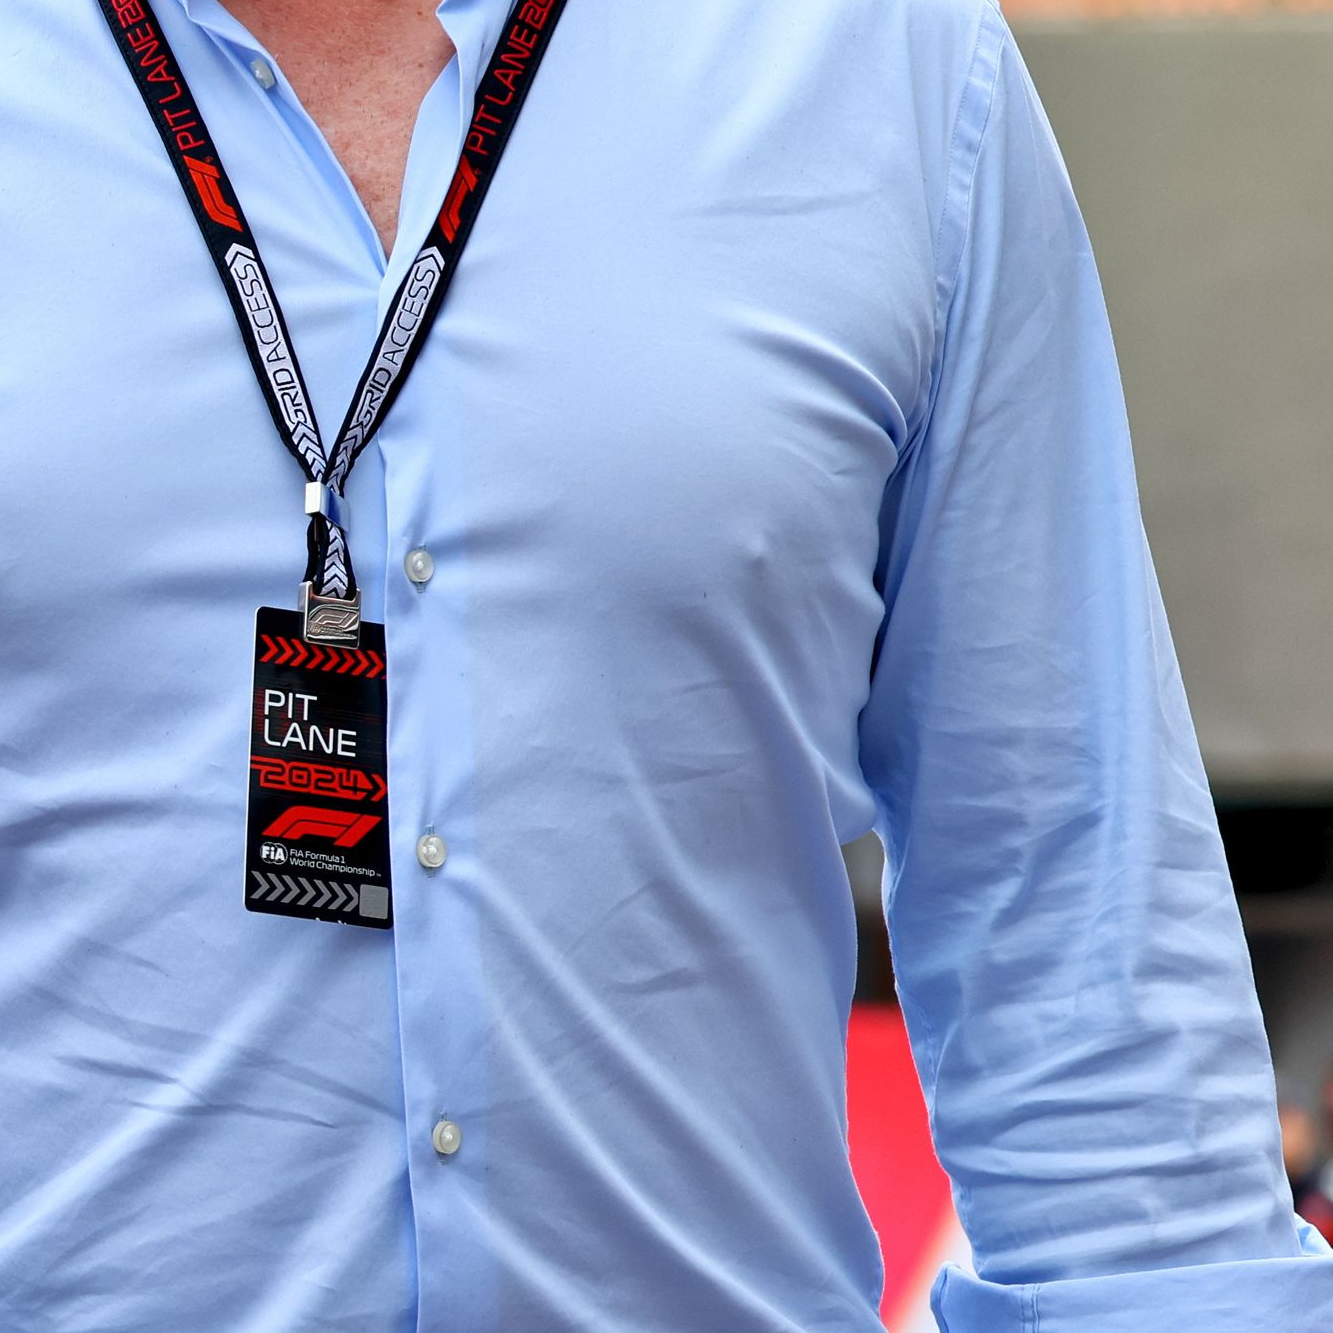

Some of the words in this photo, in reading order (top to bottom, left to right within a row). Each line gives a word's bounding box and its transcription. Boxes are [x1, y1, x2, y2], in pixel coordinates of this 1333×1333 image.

[127, 22, 182, 104] LANE
[164, 108, 205, 151] PIT
[438, 153, 479, 244] F1
[465, 104, 503, 155] PIT
[485, 24, 539, 106] LANE
[183, 153, 243, 233] F1
[236, 262, 286, 363] ACCESS
[356, 366, 391, 427] GRID
[383, 265, 434, 366] ACCESS
[274, 368, 308, 425] GRID
[263, 689, 318, 721] PIT
[263, 718, 358, 758] LANE
[253, 756, 373, 801] 2024
[262, 806, 383, 848] F1
[289, 848, 304, 858] FIA
[305, 850, 340, 863] Formula
[289, 857, 315, 869] World
[315, 861, 376, 877] Championship
